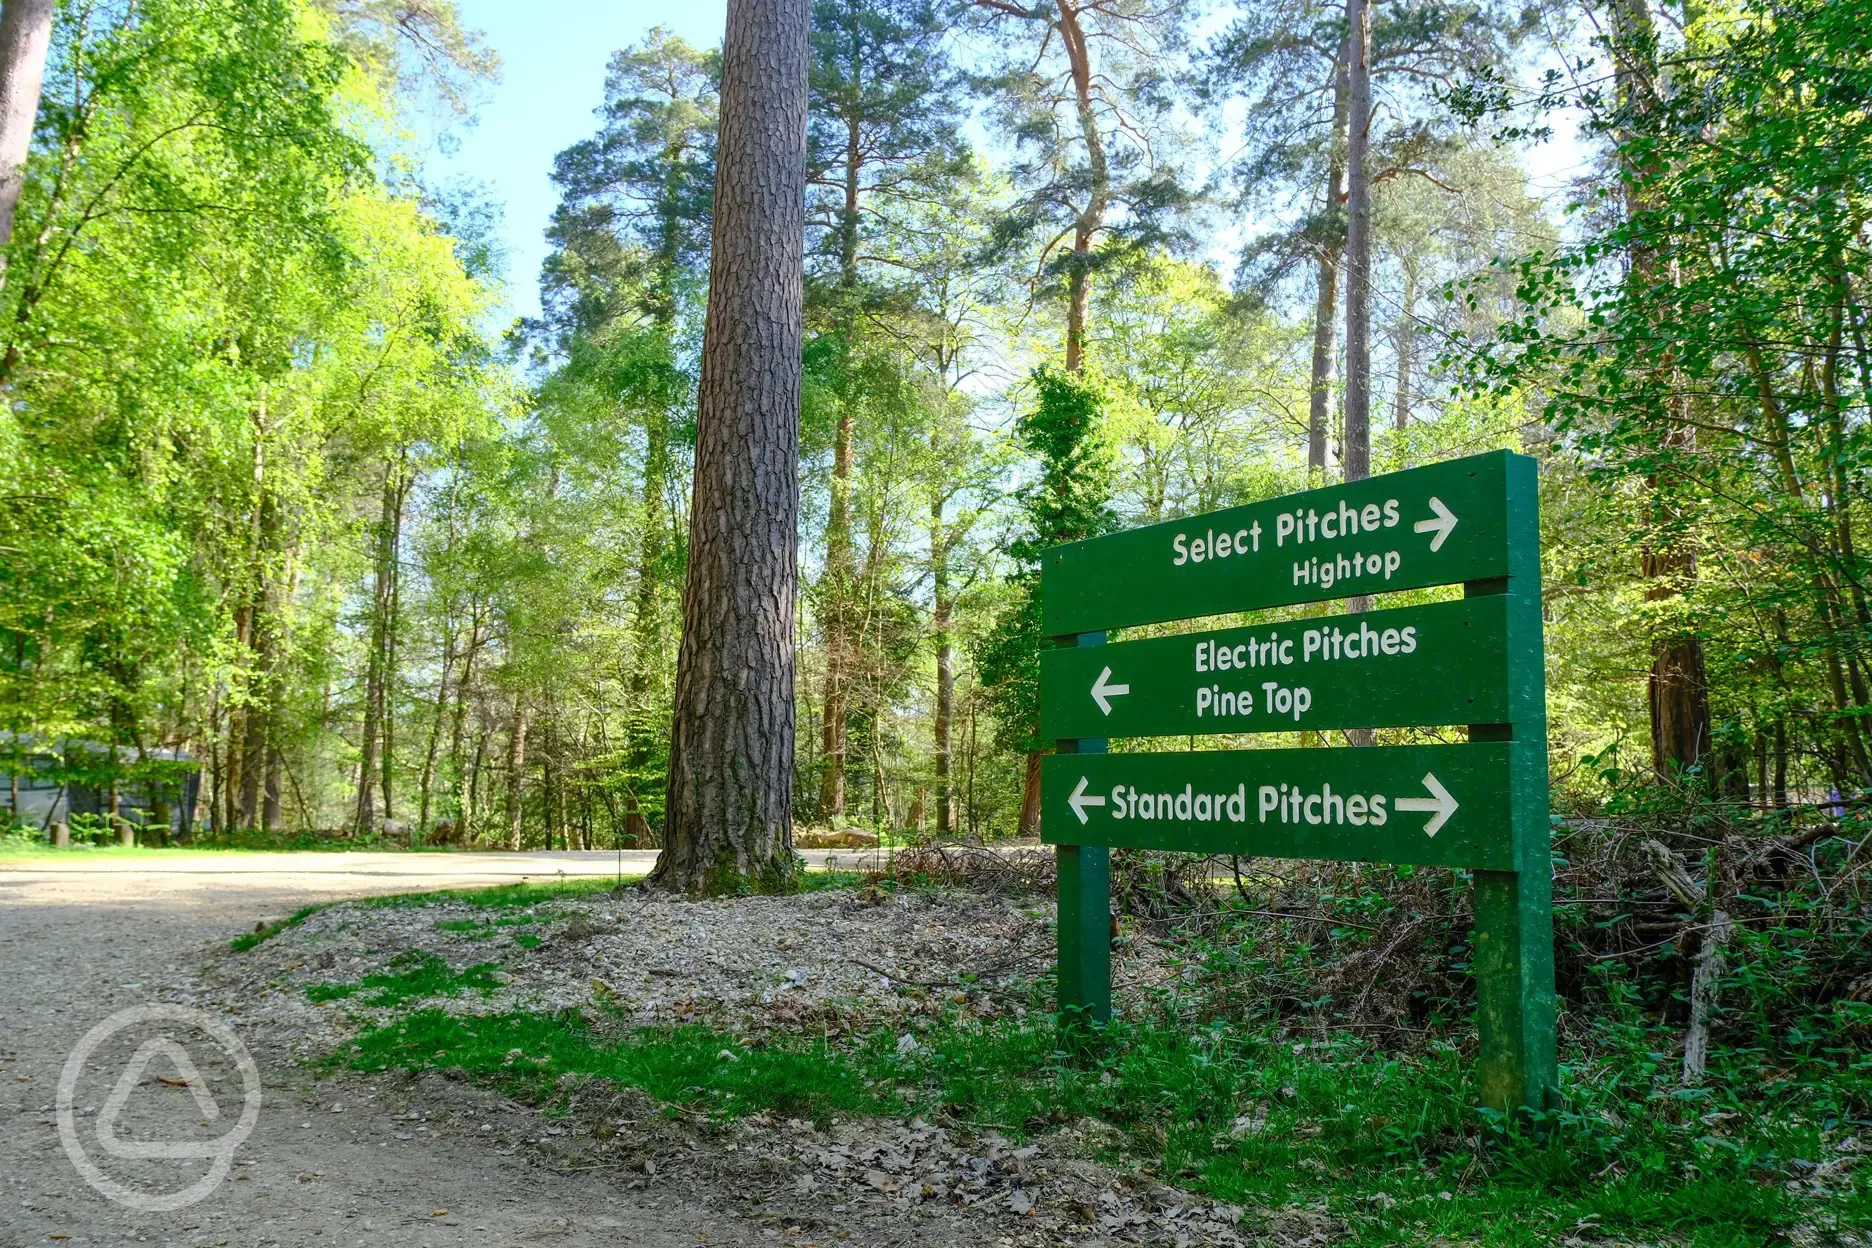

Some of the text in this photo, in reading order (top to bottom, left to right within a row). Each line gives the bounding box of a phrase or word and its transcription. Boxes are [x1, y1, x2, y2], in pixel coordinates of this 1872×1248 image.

[1172, 499, 1400, 566] Select Pitches
[1293, 550, 1401, 589] Hightop
[1195, 621, 1417, 672] Electric Pitches
[1196, 681, 1312, 722] Pine Top
[1111, 783, 1388, 826] Standard Pitches
